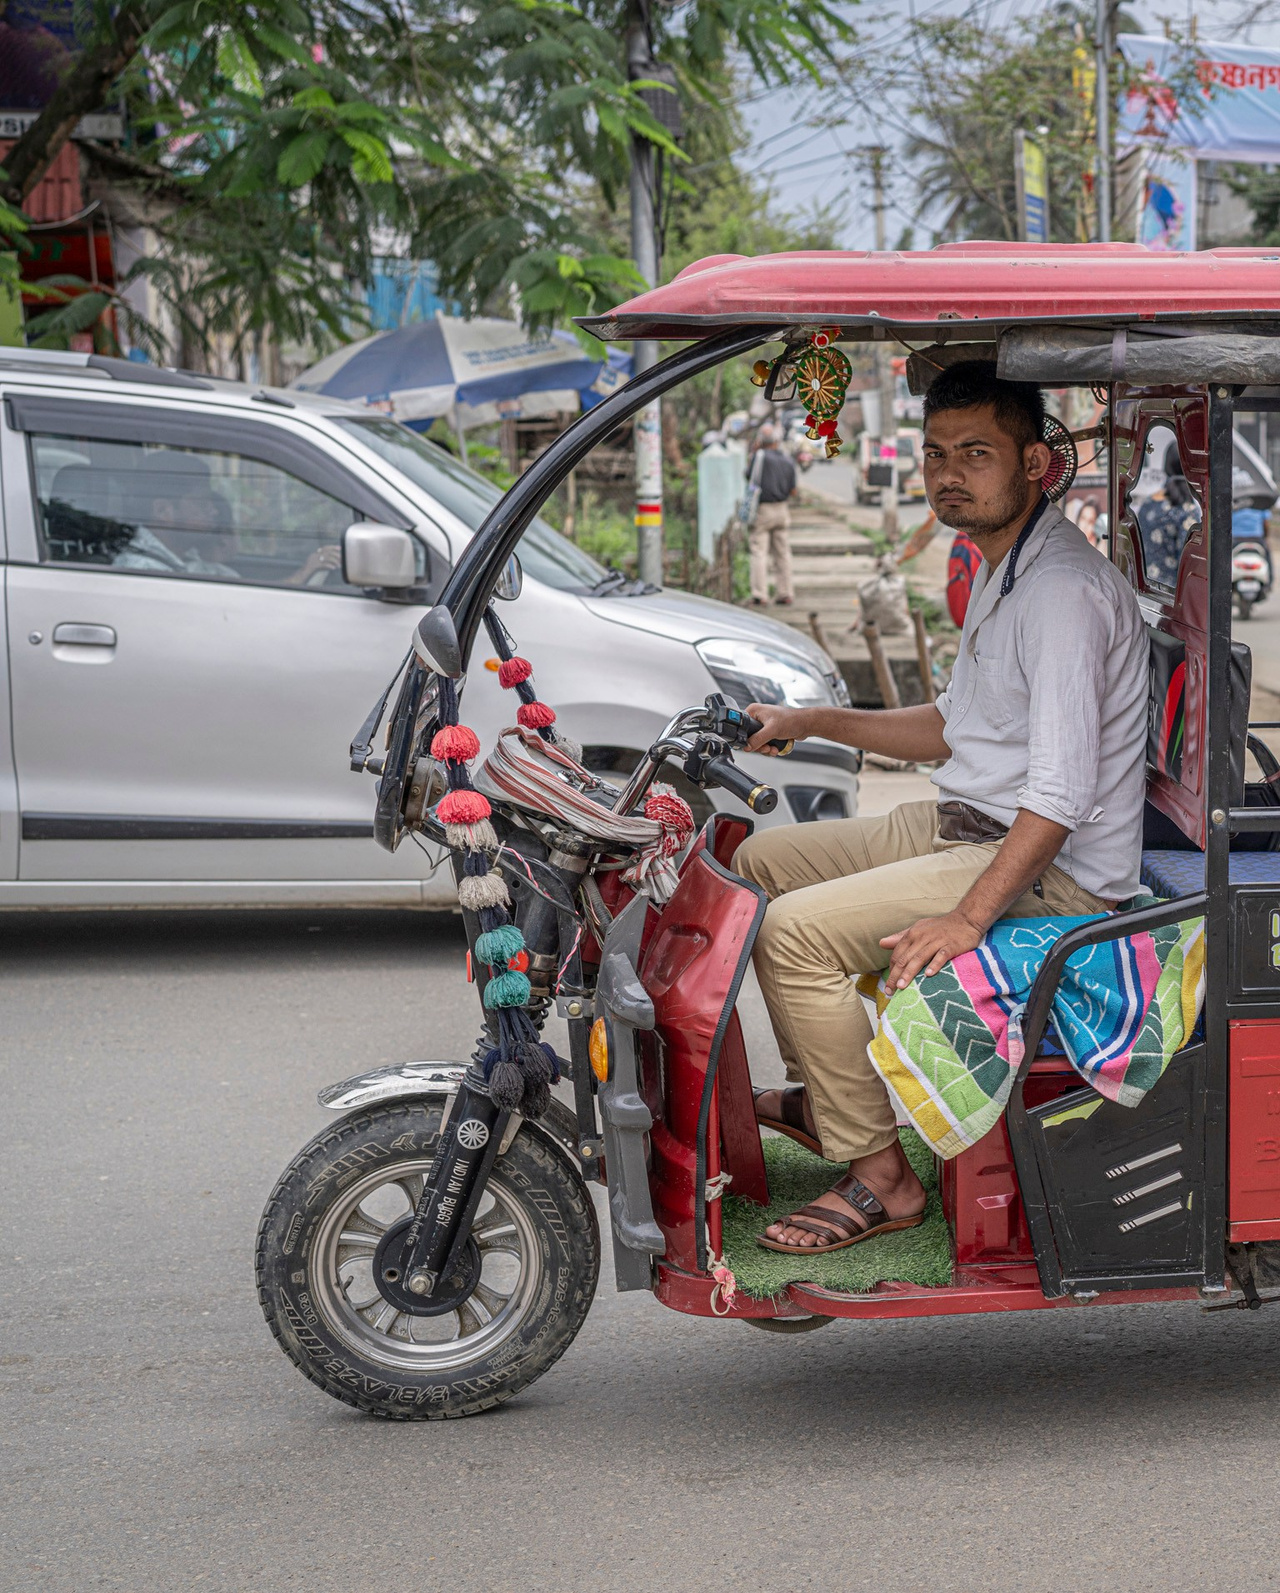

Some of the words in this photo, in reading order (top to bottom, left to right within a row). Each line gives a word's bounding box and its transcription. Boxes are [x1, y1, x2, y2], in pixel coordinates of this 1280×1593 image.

[447, 1158, 470, 1194] INDIAN
[436, 1195, 458, 1228] BUGGY
[298, 1292, 318, 1325] BA23
